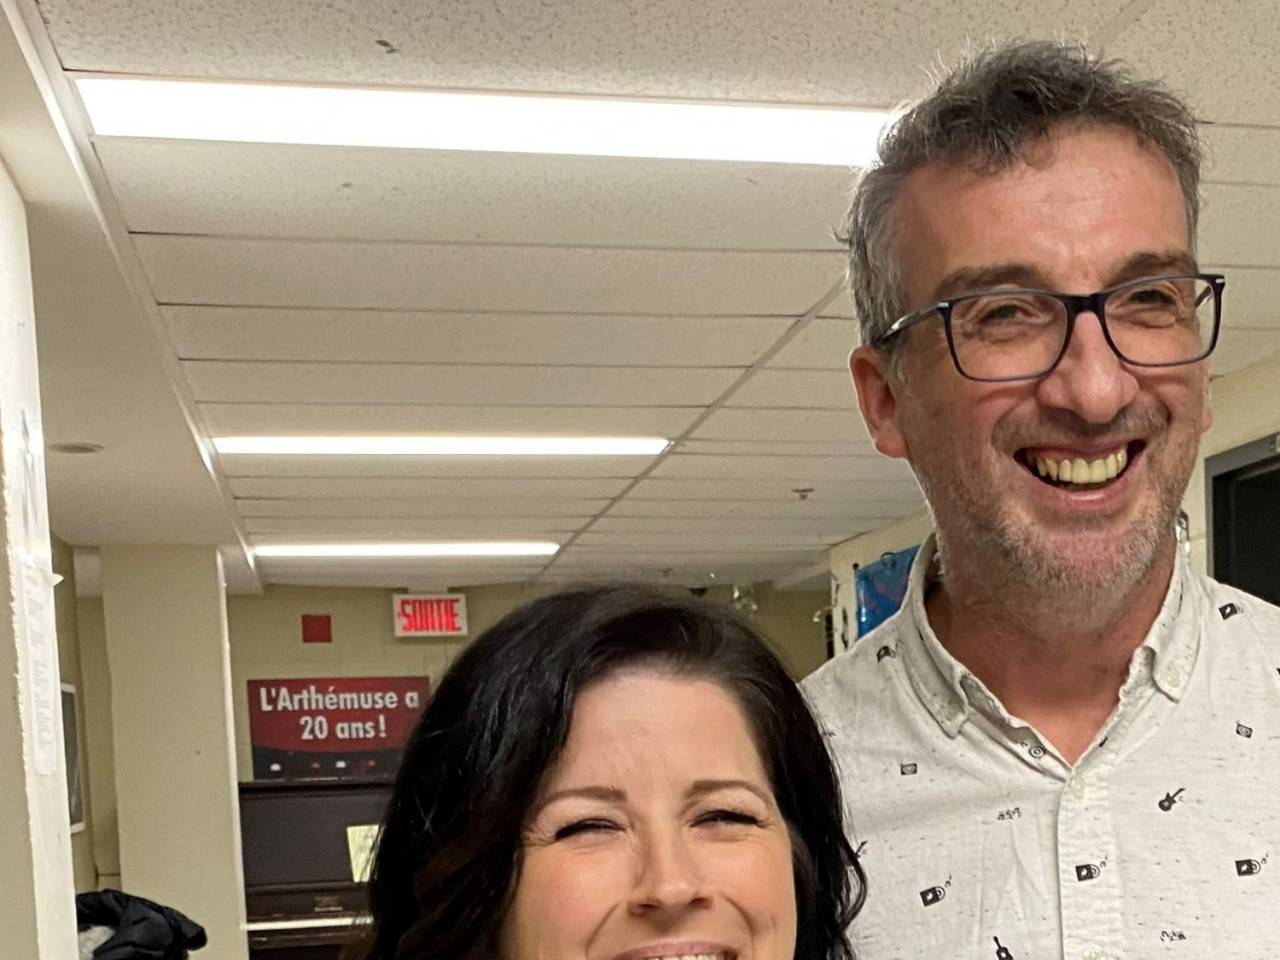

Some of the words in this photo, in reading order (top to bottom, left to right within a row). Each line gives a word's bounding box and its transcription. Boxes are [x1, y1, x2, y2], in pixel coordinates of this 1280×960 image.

[400, 599, 461, 632] SORTIE
[260, 685, 398, 711] L'Arthémuse
[405, 691, 419, 708] a
[300, 716, 328, 740] 20
